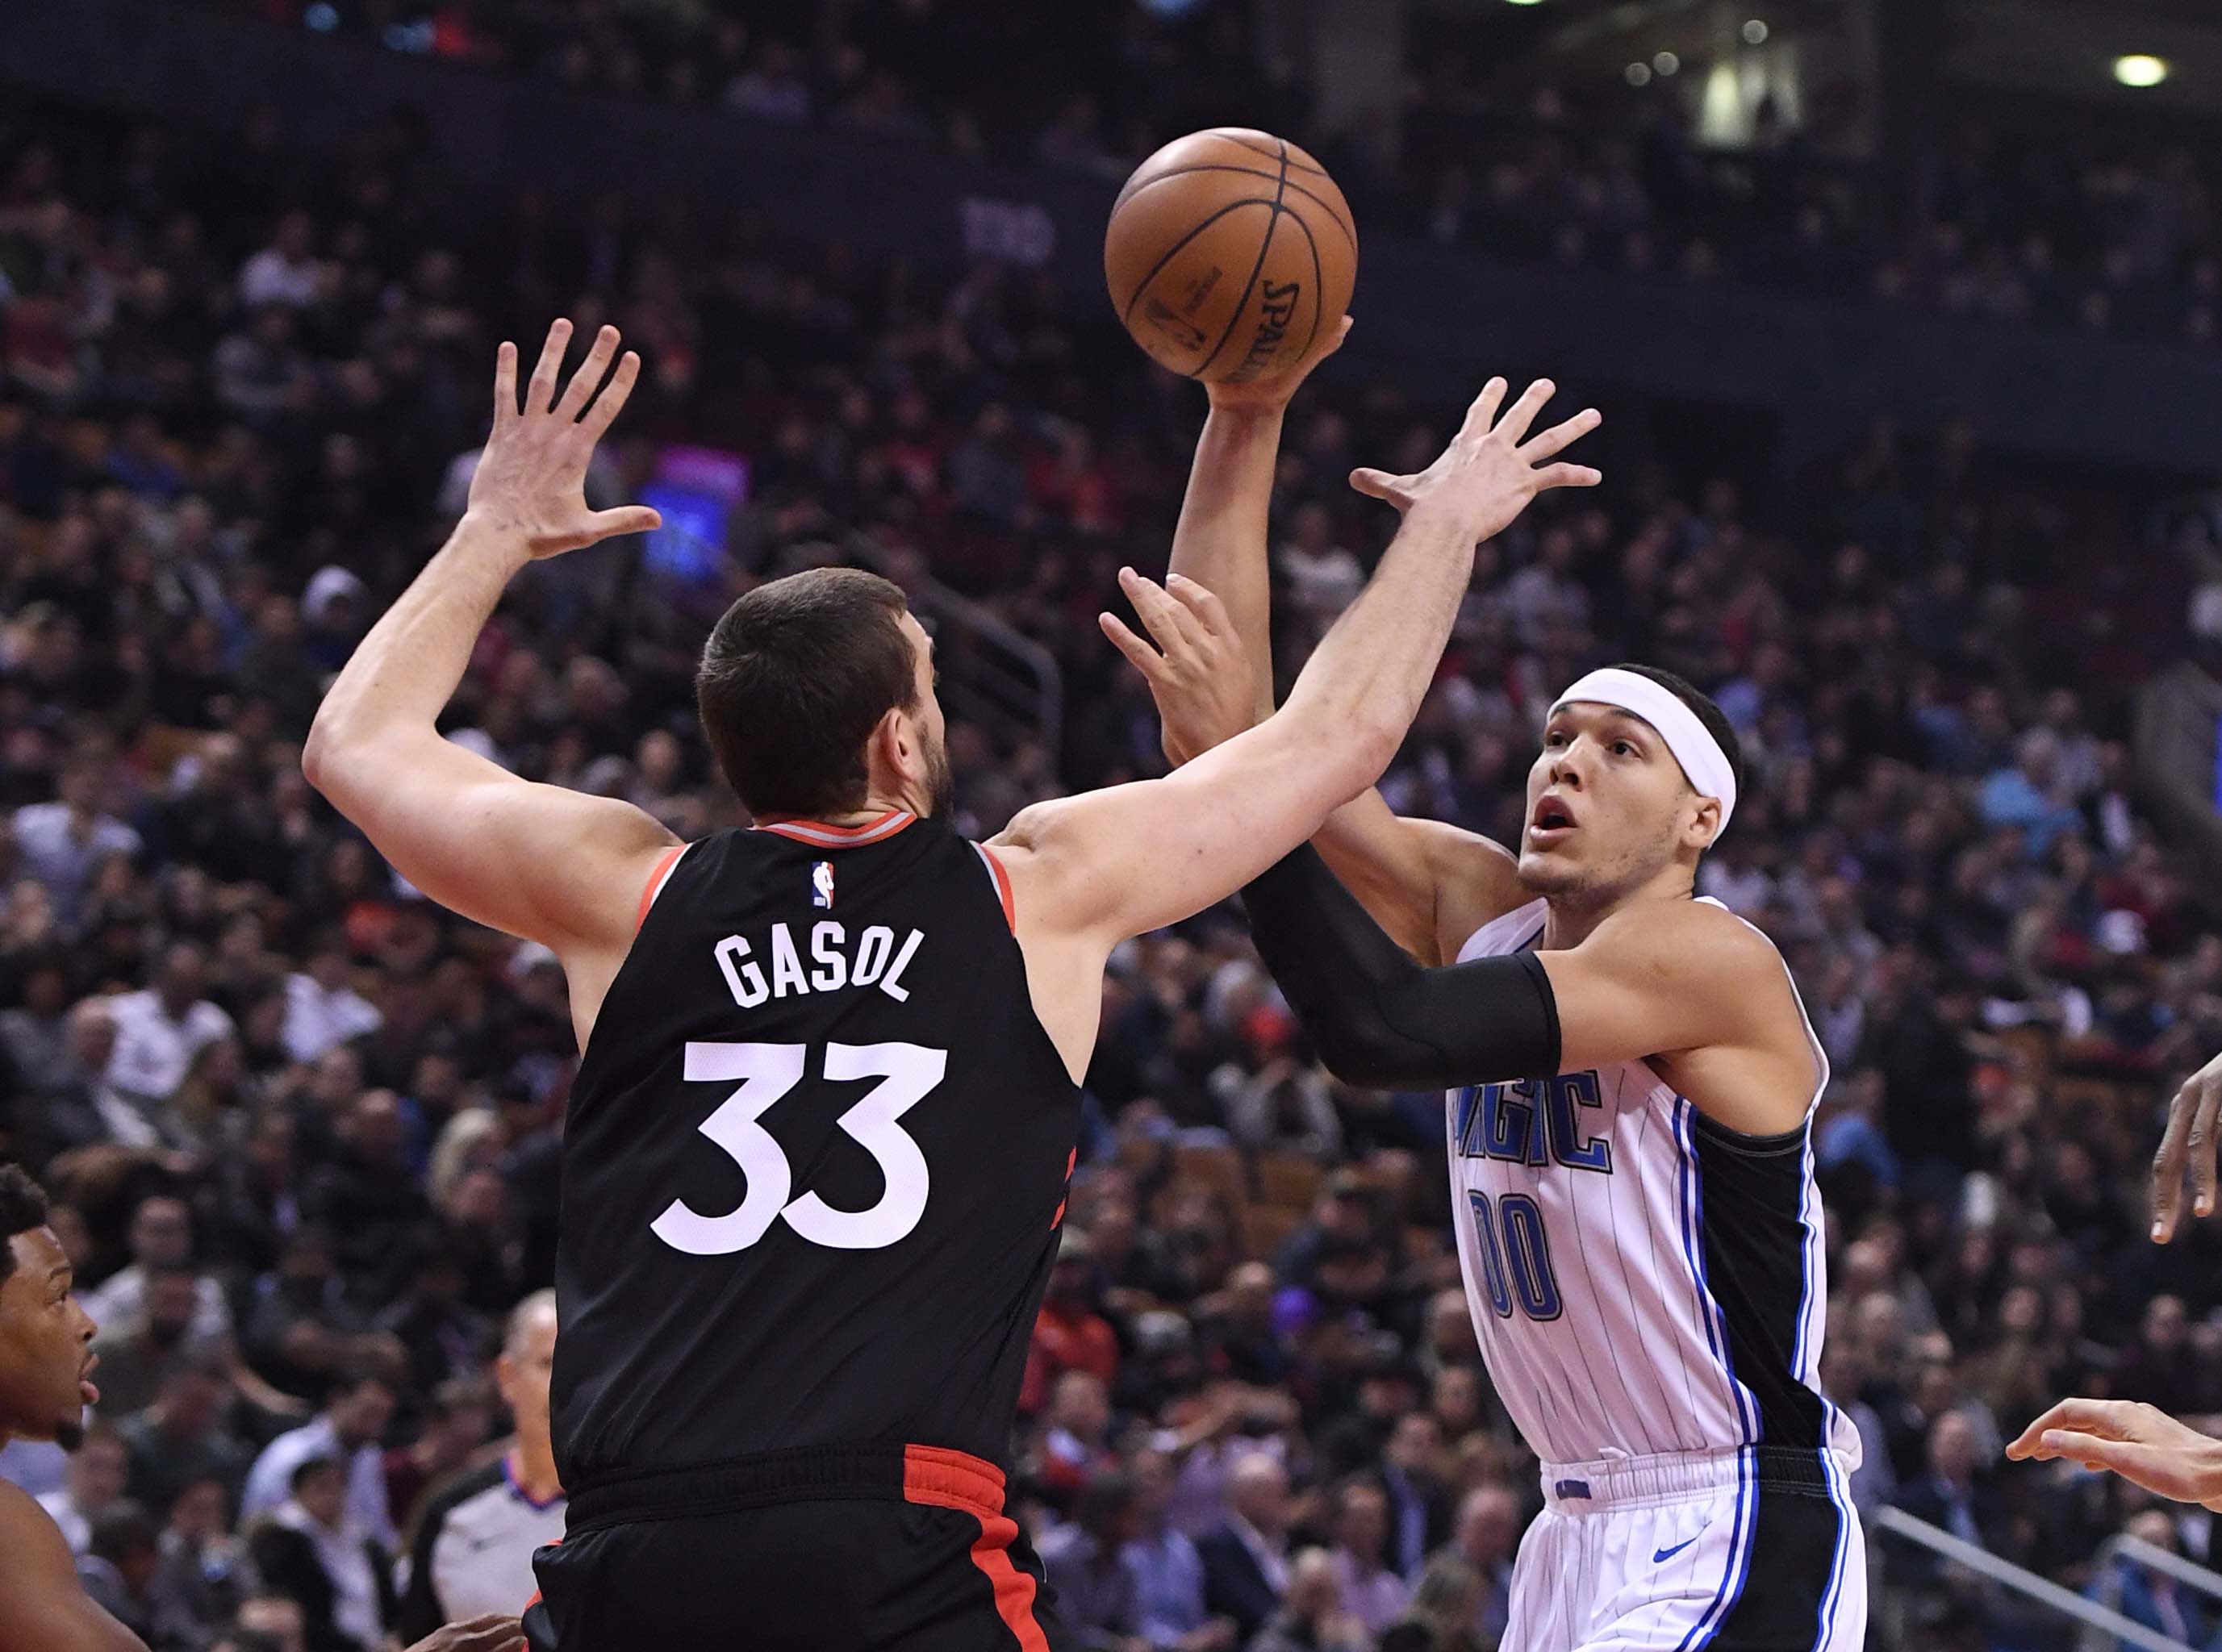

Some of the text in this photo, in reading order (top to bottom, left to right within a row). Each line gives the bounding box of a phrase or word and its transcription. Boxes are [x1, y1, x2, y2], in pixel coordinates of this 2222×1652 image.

[714, 920, 925, 1008] GASOL
[649, 1041, 948, 1255] 33
[1456, 1069, 1614, 1175] GIC
